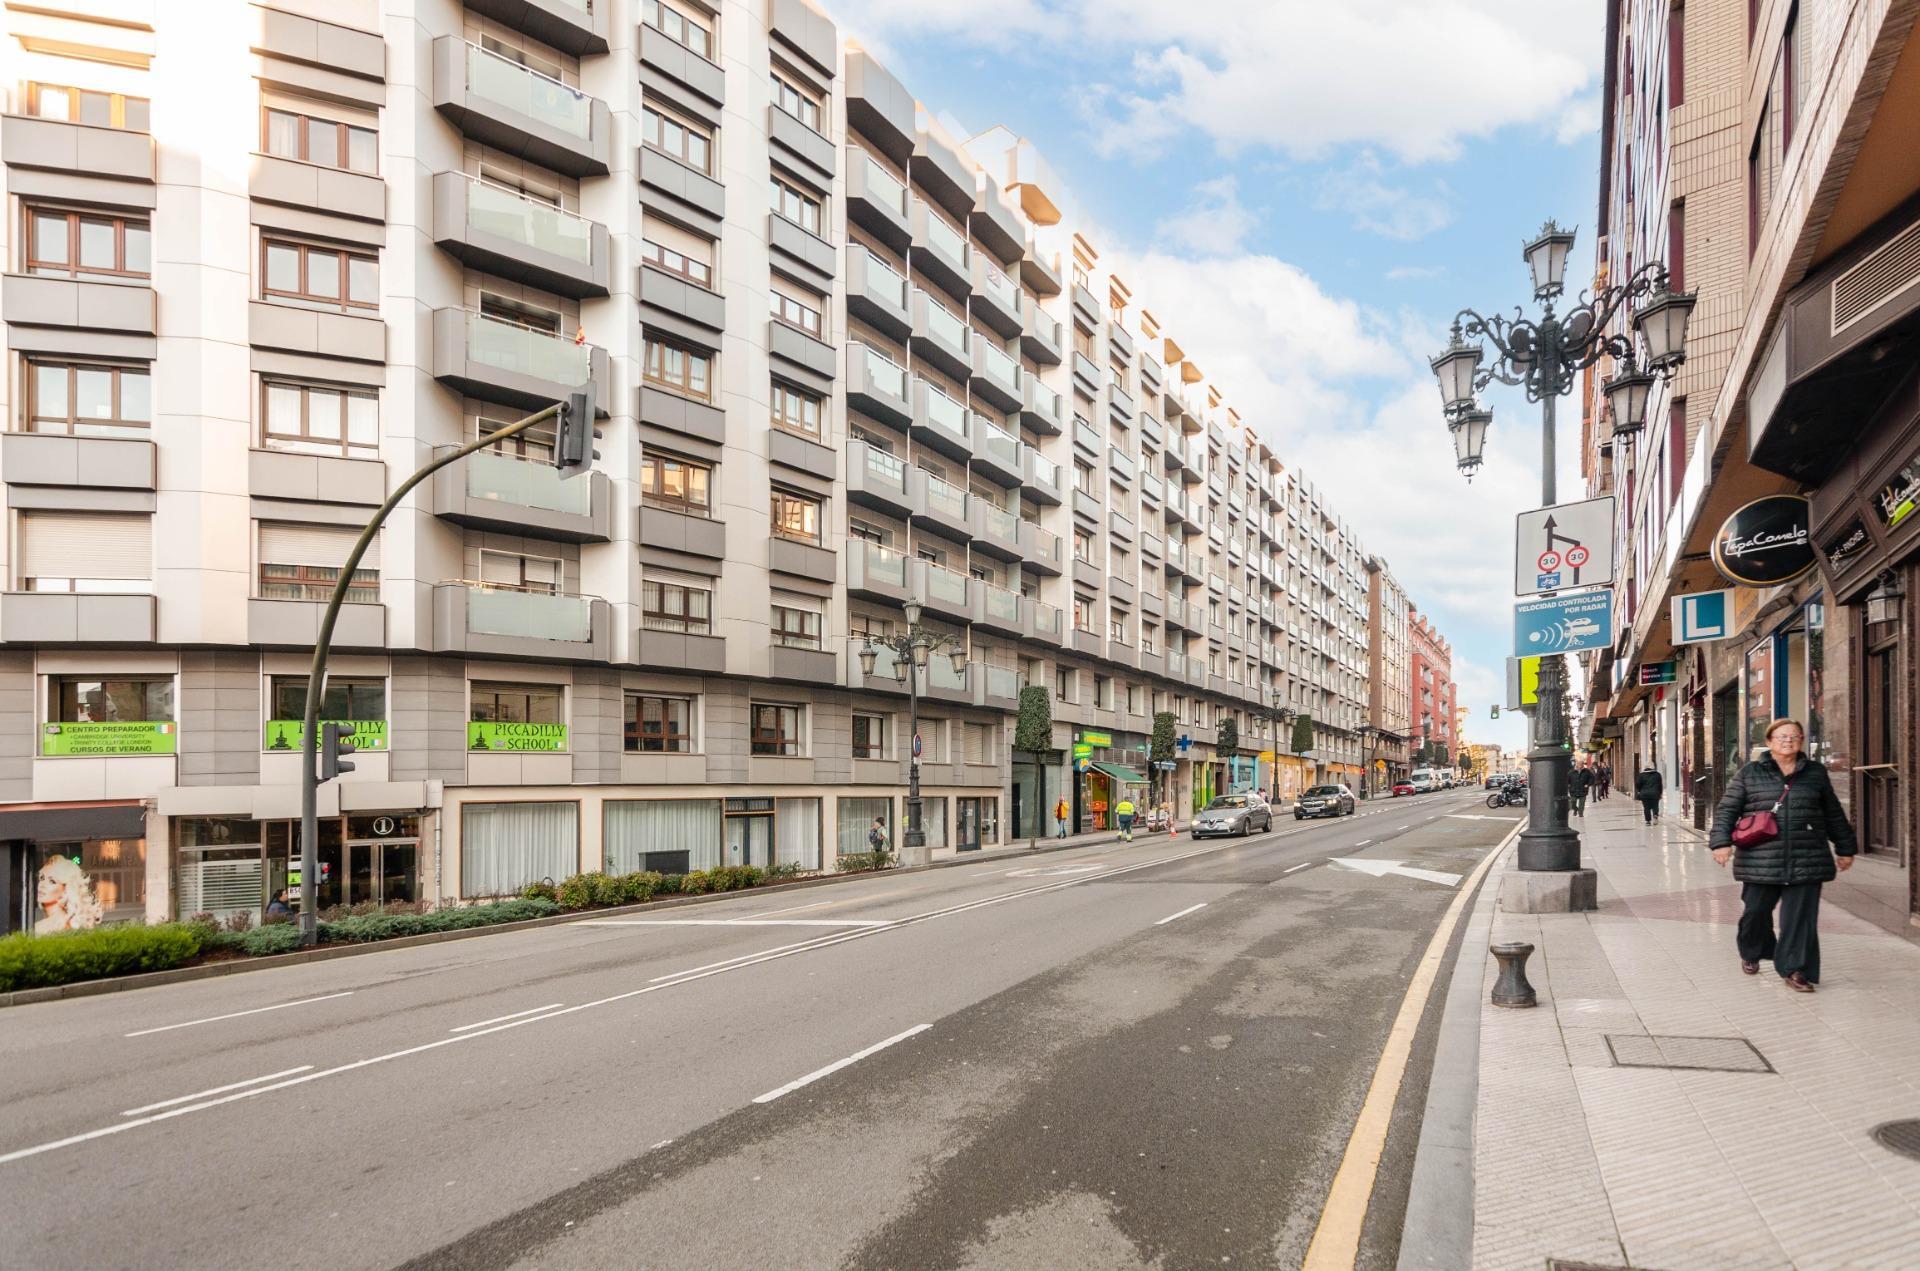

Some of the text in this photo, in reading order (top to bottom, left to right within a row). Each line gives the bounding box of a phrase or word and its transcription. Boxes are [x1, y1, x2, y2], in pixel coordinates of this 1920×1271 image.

[1543, 557, 1556, 565] 30
[1518, 595, 1607, 613] VELOCIDAD CONTROLADA
[1564, 602, 1607, 614] POR RADAR
[1686, 599, 1721, 638] L
[495, 724, 565, 737] PICCADILLY
[507, 738, 553, 750] SCHOOL
